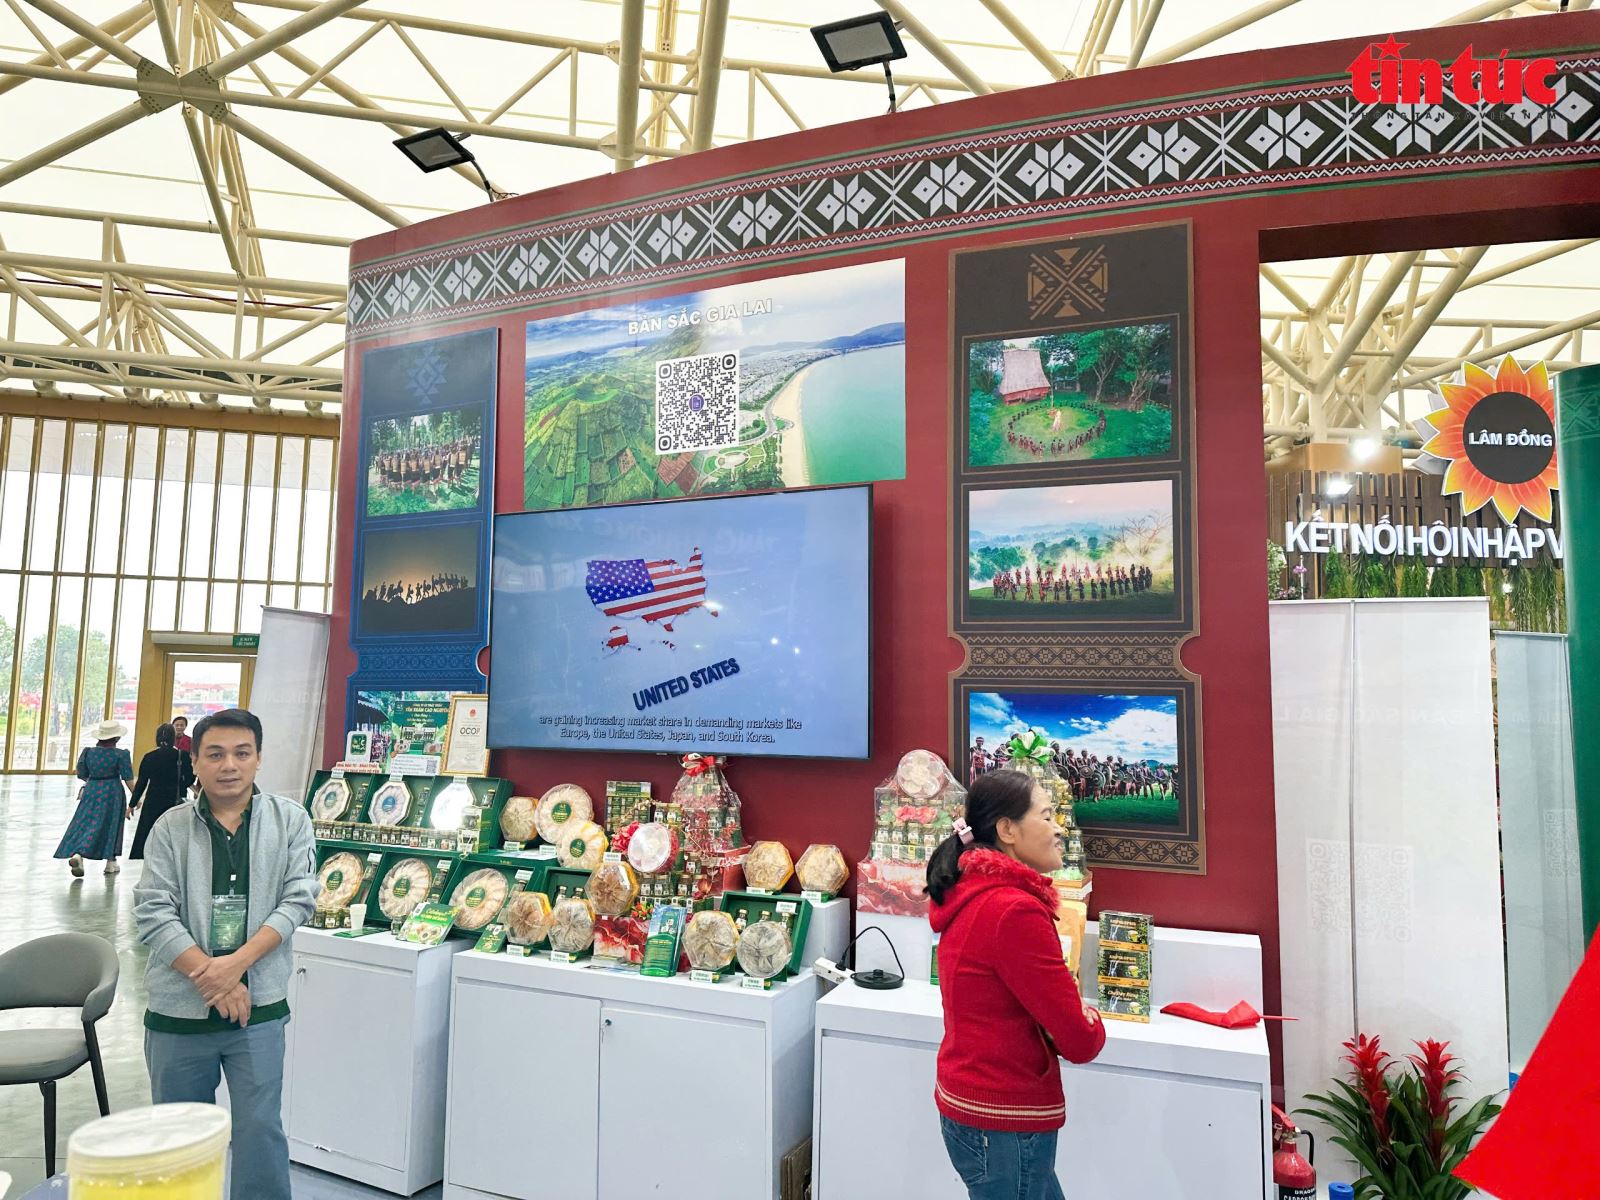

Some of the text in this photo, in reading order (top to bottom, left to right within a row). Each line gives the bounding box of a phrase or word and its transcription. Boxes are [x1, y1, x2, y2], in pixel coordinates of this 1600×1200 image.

[628, 298, 773, 336] BẢN SẮC GIA LAI
[1468, 428, 1553, 448] LÂM ĐỒNG
[1285, 509, 1349, 554] KẾT
[1350, 515, 1403, 556] NỐI
[1407, 520, 1459, 565] HỘI
[1460, 523, 1546, 566] NHẬP
[632, 657, 739, 711] UNITED STATES
[539, 715, 802, 730] are gaining increasing market share in demanding markets like
[560, 729, 776, 743] Europe, the United States, Japan, and South Korea.
